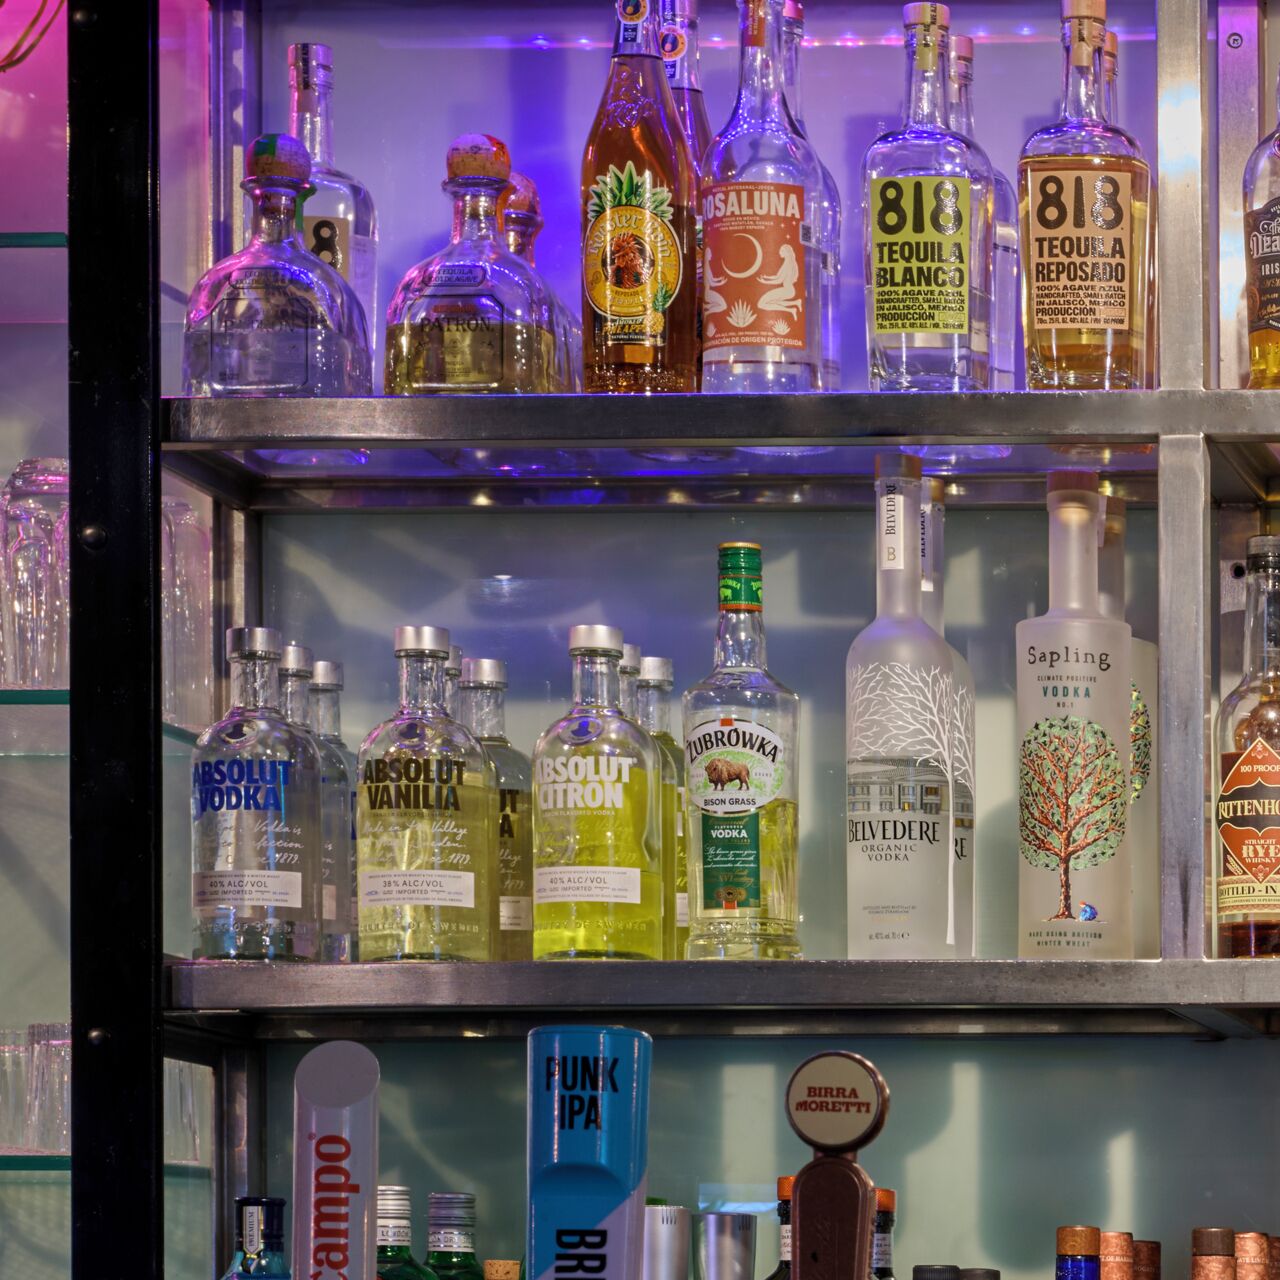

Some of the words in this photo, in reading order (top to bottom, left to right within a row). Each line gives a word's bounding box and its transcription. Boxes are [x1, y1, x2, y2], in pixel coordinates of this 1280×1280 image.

[877, 180, 964, 236] 818
[1037, 175, 1124, 230] 818
[876, 242, 964, 264] TEQUILA
[1036, 237, 1125, 258] TEQUILA
[876, 266, 964, 288] BLANCO
[1036, 262, 1125, 283] REPOSADO
[1028, 646, 1112, 672] Sapling
[1042, 685, 1092, 699] VODKA
[193, 760, 294, 786] ABSOLUT
[364, 758, 466, 785] ABSOLUT
[1240, 766, 1253, 774] 100
[200, 786, 283, 812] VODKA
[704, 798, 727, 806] BISON
[728, 798, 756, 806] GRASS
[711, 829, 748, 838] VODKA
[848, 819, 940, 846] BELVEDERE
[1242, 844, 1280, 858] RYE
[546, 1056, 620, 1095] PUNK
[806, 1086, 860, 1100] BIRRA
[558, 1094, 602, 1131] IPA
[795, 1100, 872, 1116] MORETTI
